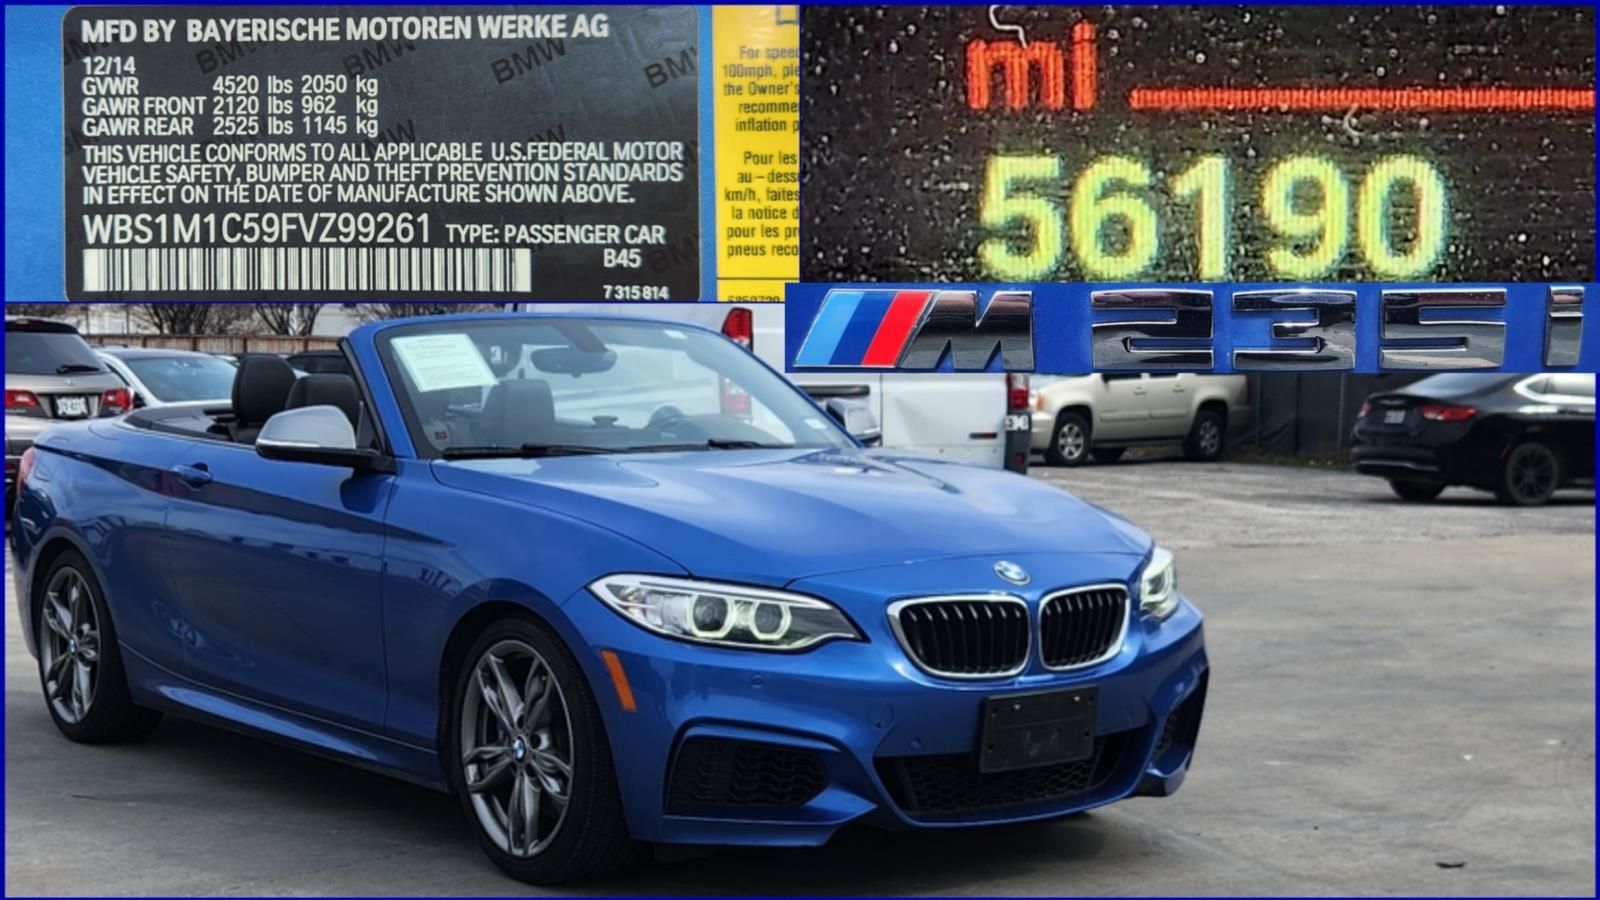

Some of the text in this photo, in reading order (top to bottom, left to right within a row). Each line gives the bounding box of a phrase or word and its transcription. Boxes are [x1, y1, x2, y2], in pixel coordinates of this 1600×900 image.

[82, 13, 609, 42] MFD BY BAYERISCHE MOTOREN WERKE AG
[83, 56, 136, 75] 12/14
[967, 21, 1097, 110] mi
[82, 74, 378, 96] GVWR 4520 lbs 2050 kg
[724, 82, 743, 96] the
[82, 95, 378, 117] GAWR FRONT 2120 lbs 962 kg
[82, 117, 139, 136] GAWR
[144, 117, 193, 135] REAR
[213, 116, 259, 135] 2525
[268, 116, 293, 134] lbs
[303, 116, 347, 134] 1145
[357, 115, 378, 138] kg
[735, 117, 787, 132] inflation
[82, 145, 123, 163] THIS
[127, 144, 201, 163] VEHICLE
[206, 143, 306, 162] CONFORMS
[311, 143, 334, 161] TO
[338, 143, 370, 161] ALL
[374, 142, 483, 161] APPLICABLE
[614, 141, 683, 160] MOTOR
[743, 151, 797, 165] Pour les
[82, 163, 683, 186] VEHICLE SAFETY, BUMPER AND THEFT PREVENTION STANDARDS
[84, 184, 635, 204] IN EFFECT ON THE DATE OF MANUFACTURE SHOWN ABOVE.
[724, 187, 800, 203] km/h, faites
[731, 205, 743, 219] la
[748, 205, 787, 219] notice
[977, 151, 1449, 281] 56190
[83, 213, 665, 244] WBS1M1C59FVZ99261 TYPE: PASSENGER CAR
[726, 224, 756, 241] pour
[760, 224, 780, 238] les
[604, 249, 641, 267] B45
[727, 244, 767, 260] pneus
